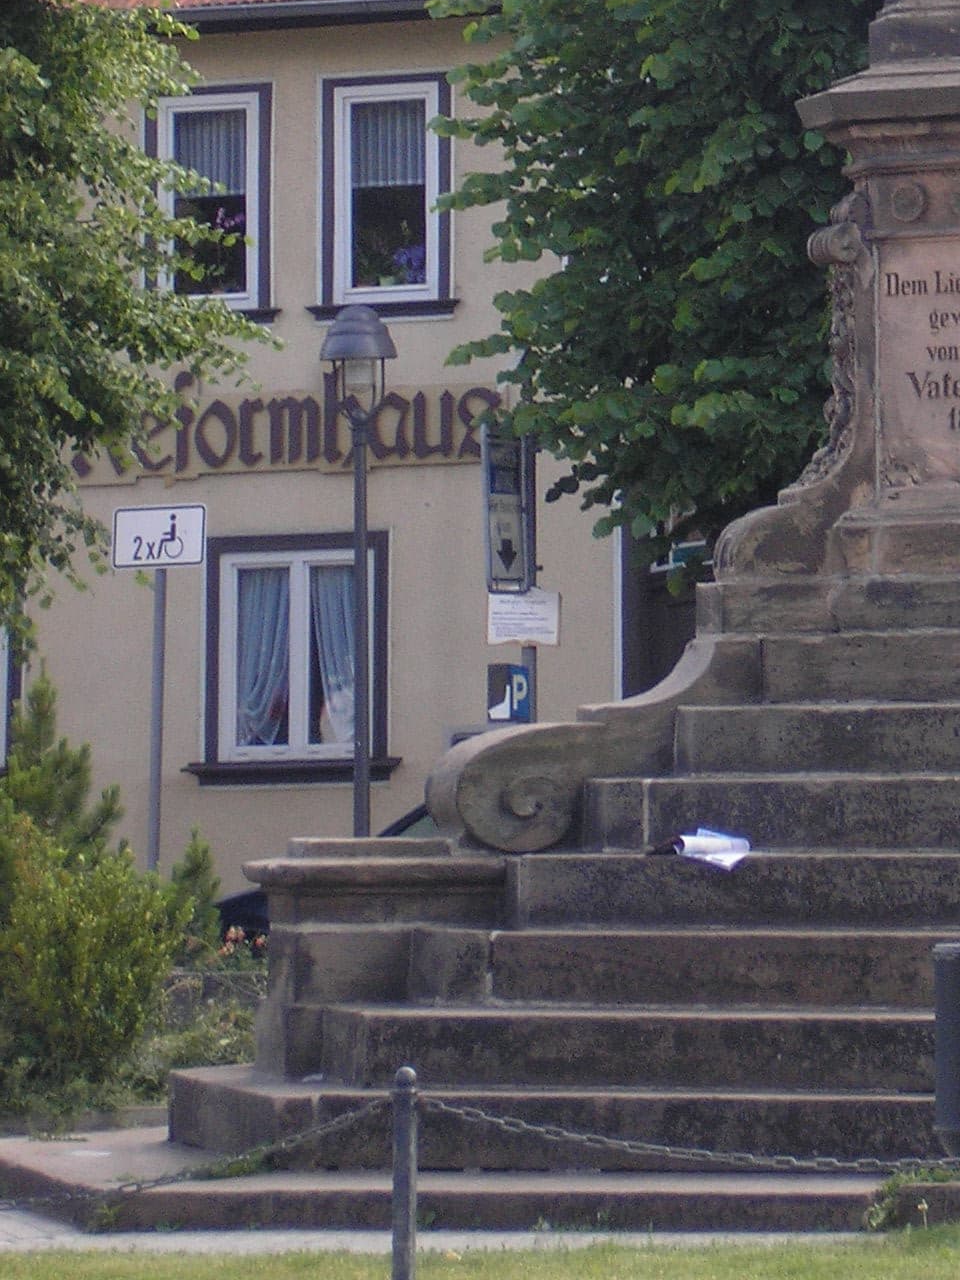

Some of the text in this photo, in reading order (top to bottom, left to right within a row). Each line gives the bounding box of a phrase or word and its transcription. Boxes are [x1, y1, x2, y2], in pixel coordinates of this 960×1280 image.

[885, 272, 928, 297] Dem
[926, 344, 959, 361] von
[72, 371, 502, 477] eformhaus
[512, 673, 529, 711] P
